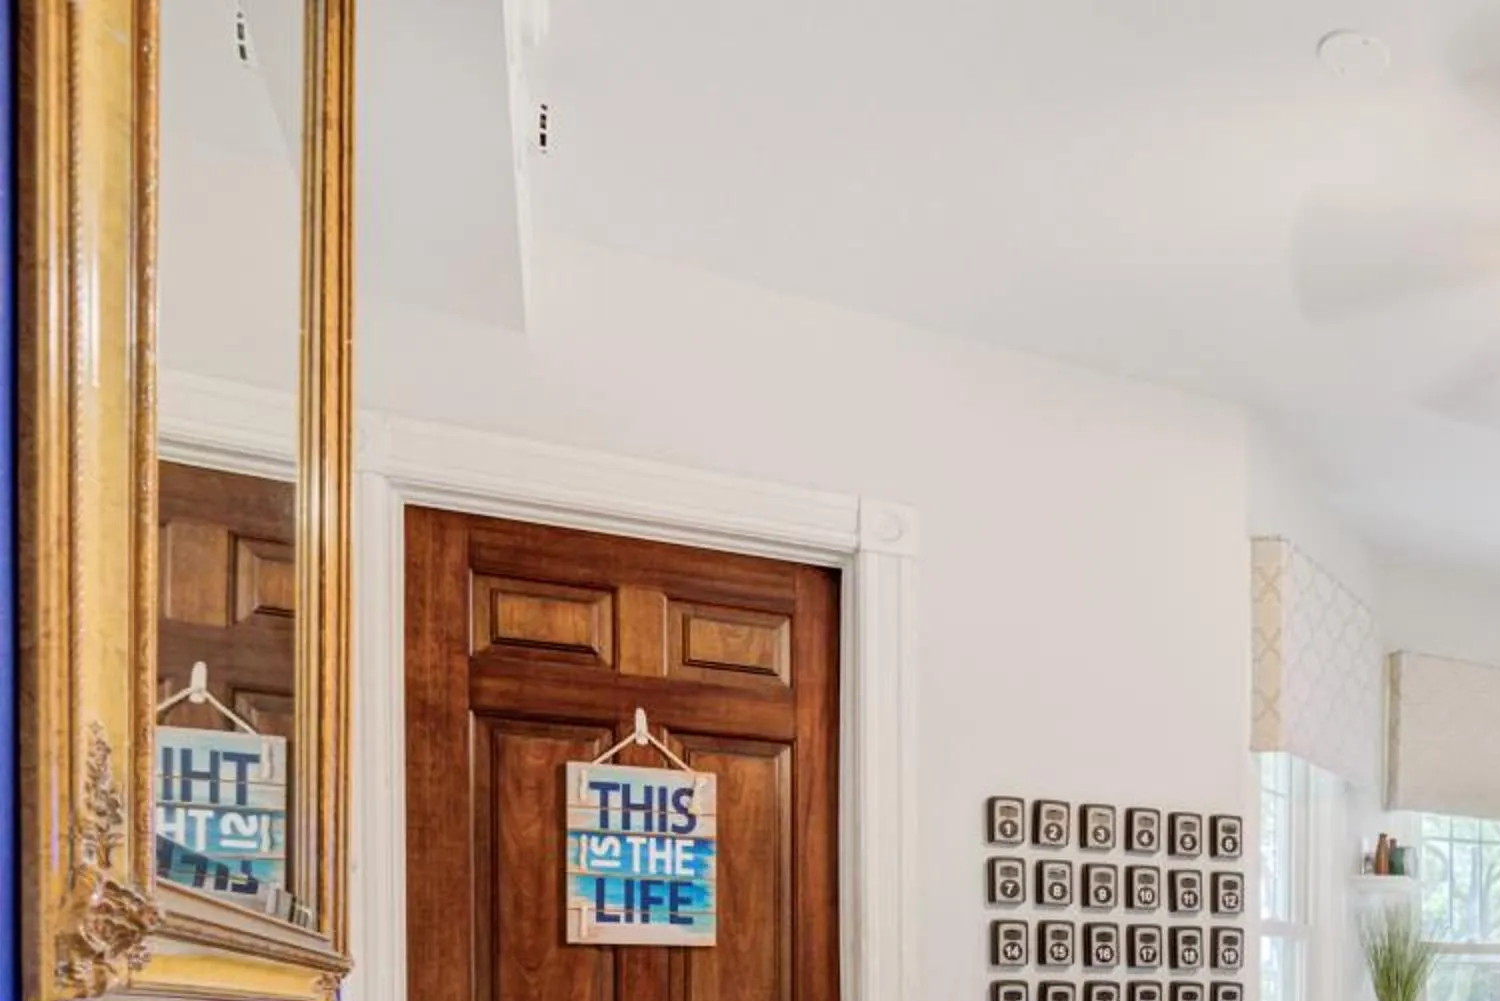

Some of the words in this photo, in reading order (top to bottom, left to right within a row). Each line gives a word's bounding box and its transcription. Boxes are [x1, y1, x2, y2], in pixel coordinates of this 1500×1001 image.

[589, 781, 697, 834] THIS
[590, 835, 621, 868] IS
[626, 837, 695, 876] THE
[596, 877, 694, 925] LIFE
[1139, 890, 1153, 901] 10
[1183, 893, 1196, 905] 11
[1224, 895, 1236, 906] 12
[1005, 946, 1020, 958] 14
[1052, 946, 1067, 958] 15
[1141, 948, 1155, 959] 17
